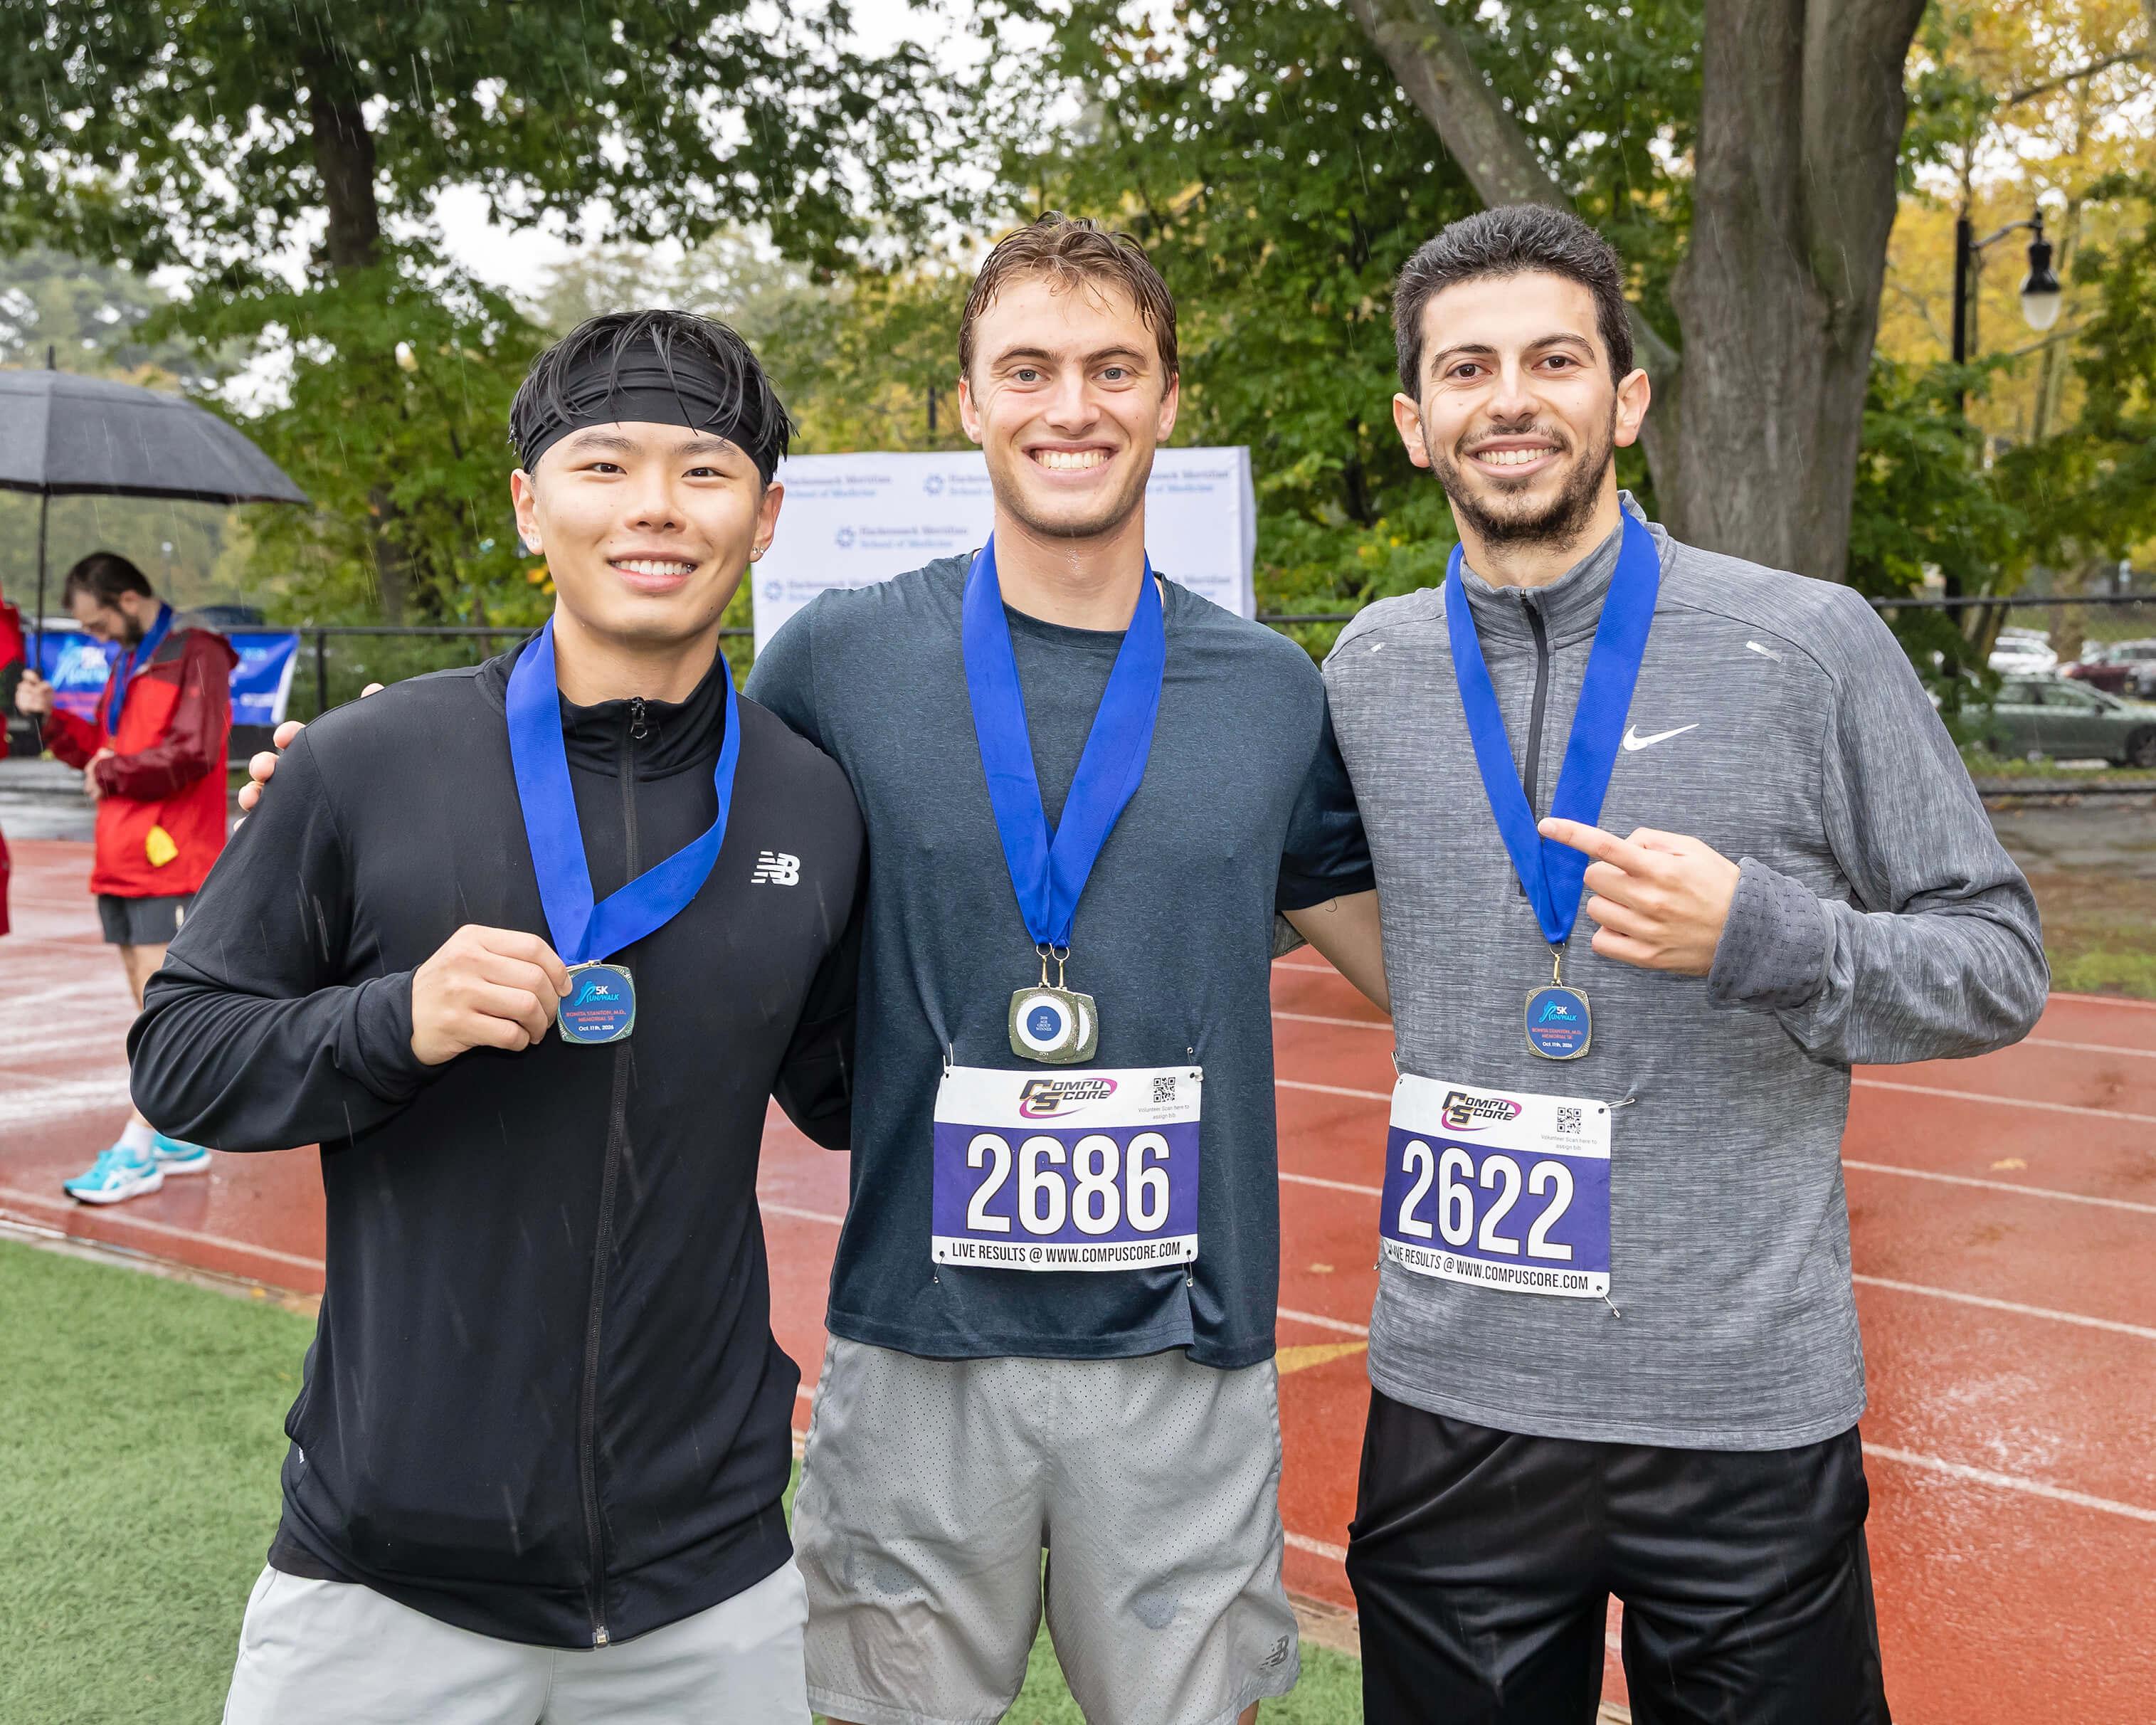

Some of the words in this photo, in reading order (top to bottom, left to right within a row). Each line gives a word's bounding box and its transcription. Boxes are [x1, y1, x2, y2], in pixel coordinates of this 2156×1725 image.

[596, 986, 609, 995] 5K
[1556, 1006, 1568, 1015] 5K
[966, 1132, 1171, 1235] 2686
[1397, 1139, 1575, 1261] 2622
[952, 1243, 975, 1258] LIVE
[979, 1246, 1025, 1262] RESULTS
[1029, 1248, 1042, 1263] @
[1046, 1242, 1180, 1263] WWW.COMPUSCORE.COM
[1405, 1249, 1441, 1269] RESULTS
[1444, 1257, 1454, 1272] @
[1457, 1260, 1588, 1290] WWW.COMPUSCORE.COM
